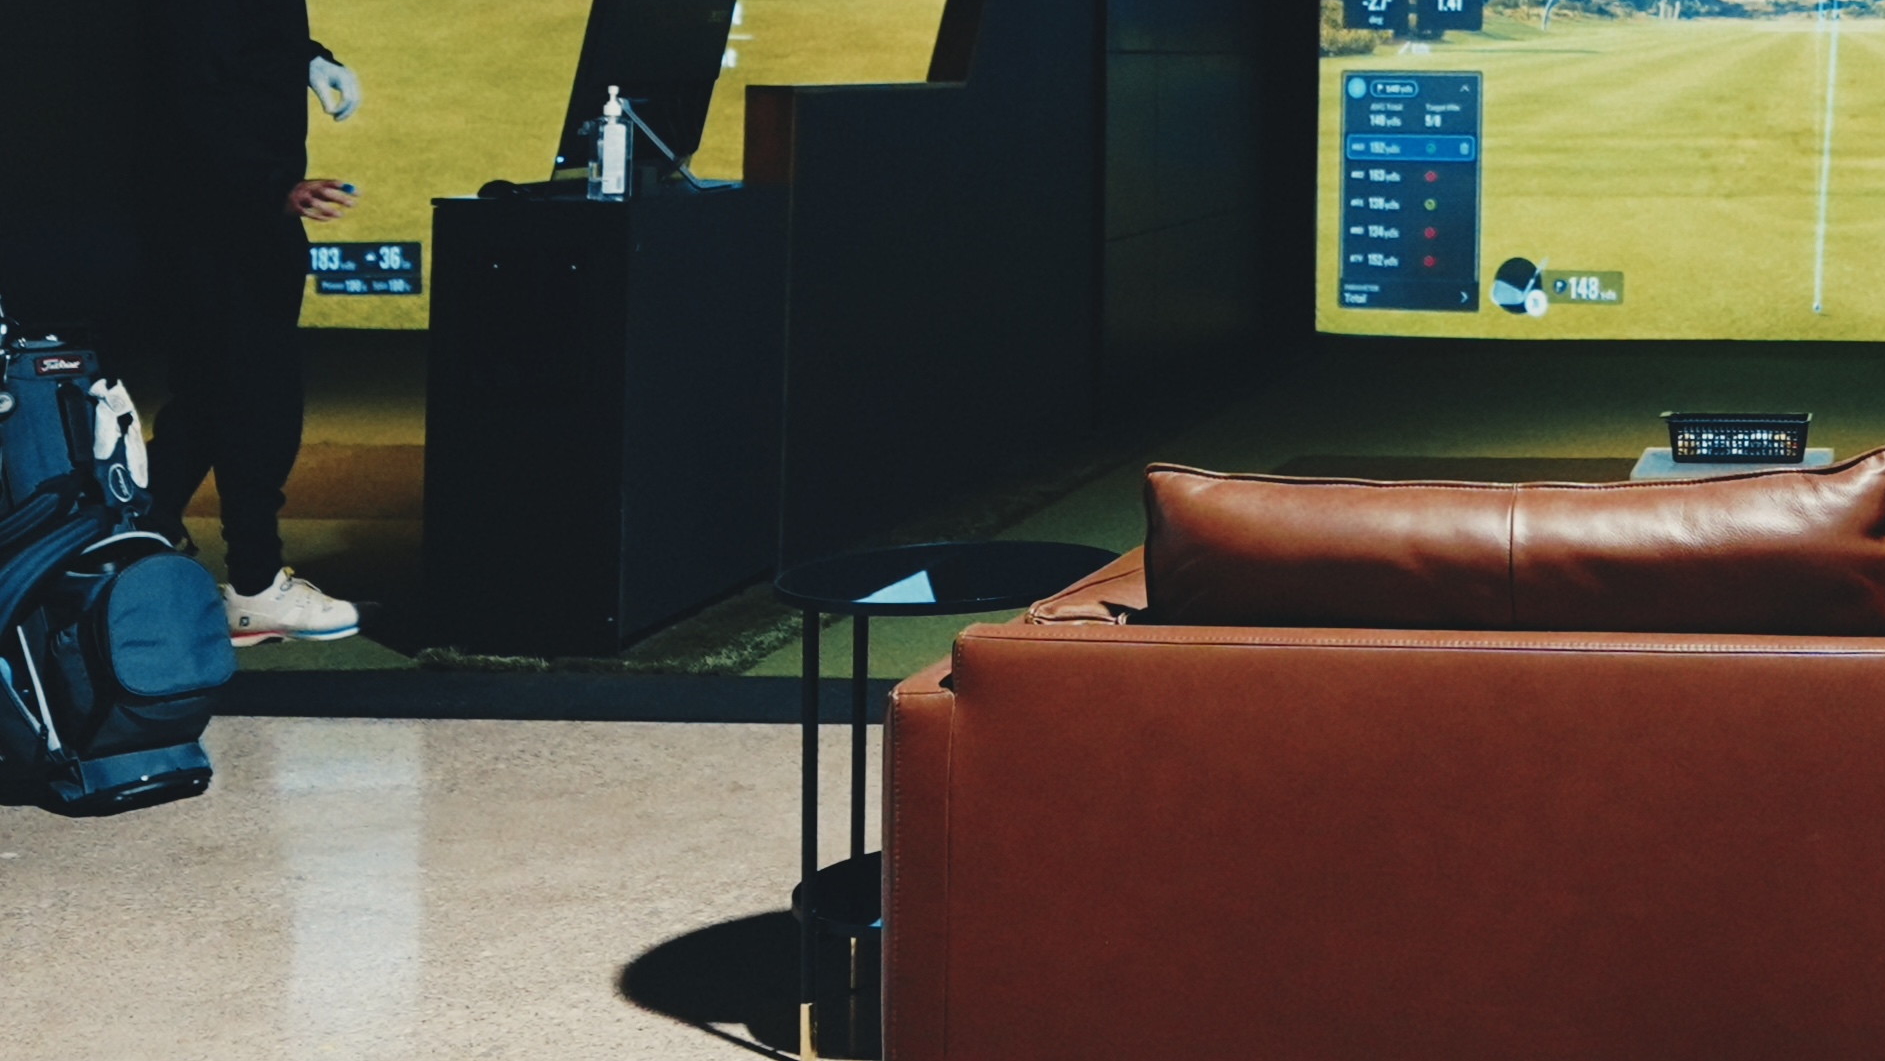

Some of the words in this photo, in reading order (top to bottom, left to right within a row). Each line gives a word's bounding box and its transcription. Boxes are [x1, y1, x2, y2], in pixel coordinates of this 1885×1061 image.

[309, 246, 340, 271] 183
[379, 245, 402, 270] 36
[1568, 276, 1599, 300] 148
